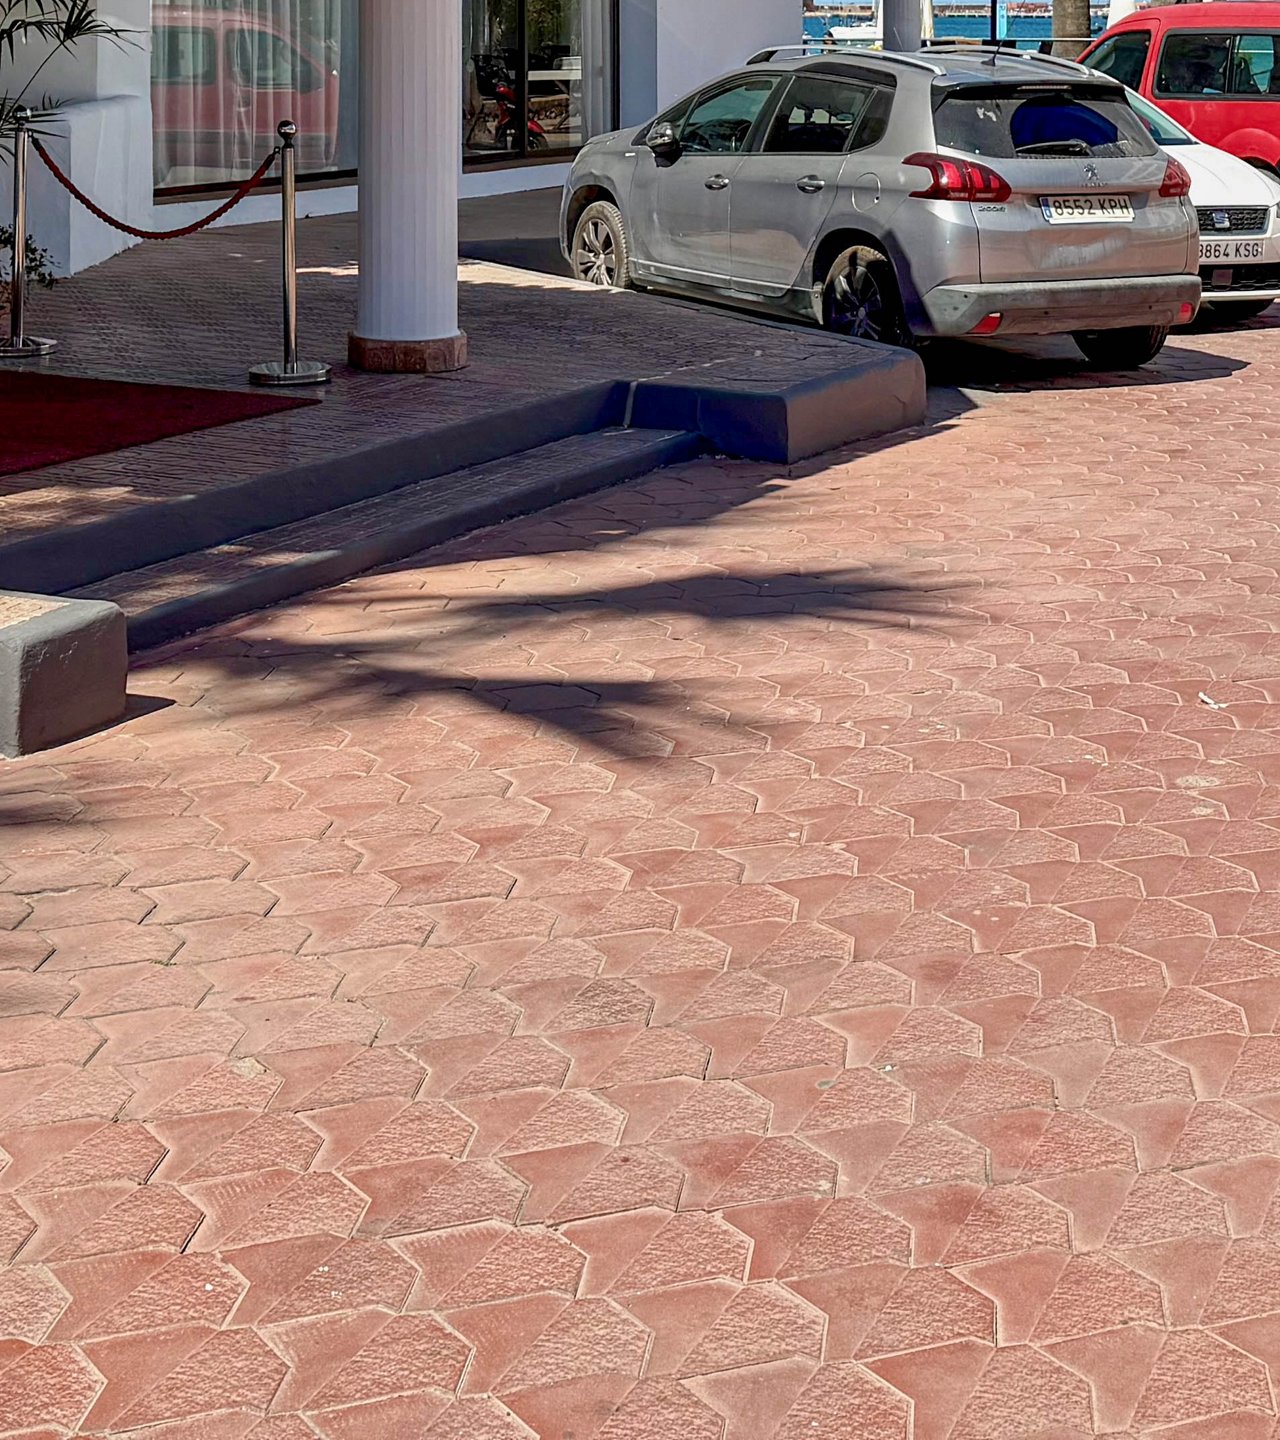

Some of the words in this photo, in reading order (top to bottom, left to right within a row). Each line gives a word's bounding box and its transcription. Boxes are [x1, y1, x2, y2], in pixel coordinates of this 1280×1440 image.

[1053, 198, 1096, 216] 8552
[1100, 197, 1131, 215] KPH
[1234, 242, 1259, 258] KSG
